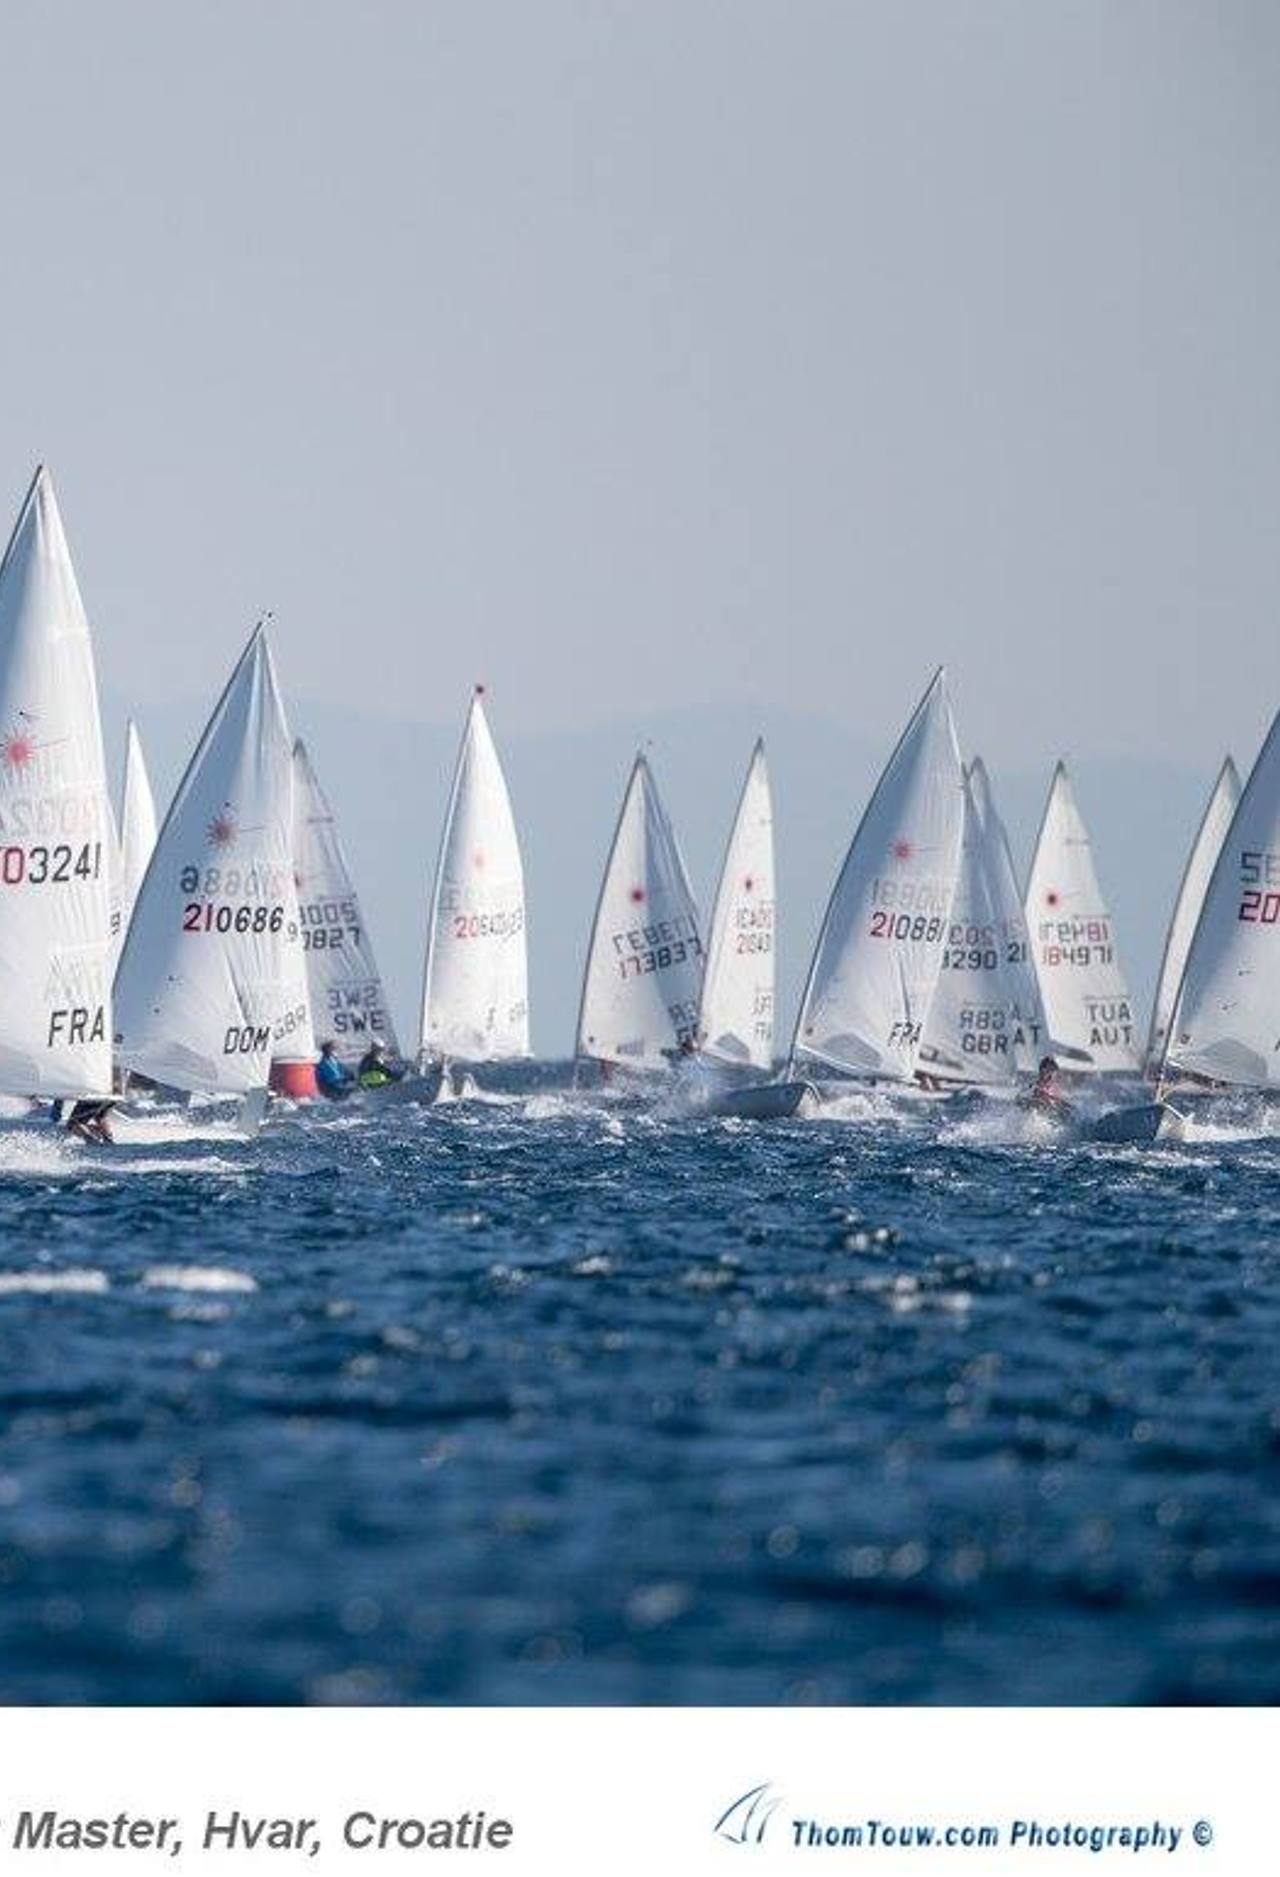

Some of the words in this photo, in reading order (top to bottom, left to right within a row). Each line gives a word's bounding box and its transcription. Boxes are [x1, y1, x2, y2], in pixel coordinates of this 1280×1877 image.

[183, 902, 284, 934] 210686
[1042, 945, 1112, 966] 184971
[48, 1006, 105, 1048] FRA
[334, 1010, 385, 1033] SWE
[224, 1026, 271, 1055] DOM
[962, 1033, 1009, 1055] GBR
[1090, 1024, 1132, 1047] AUT
